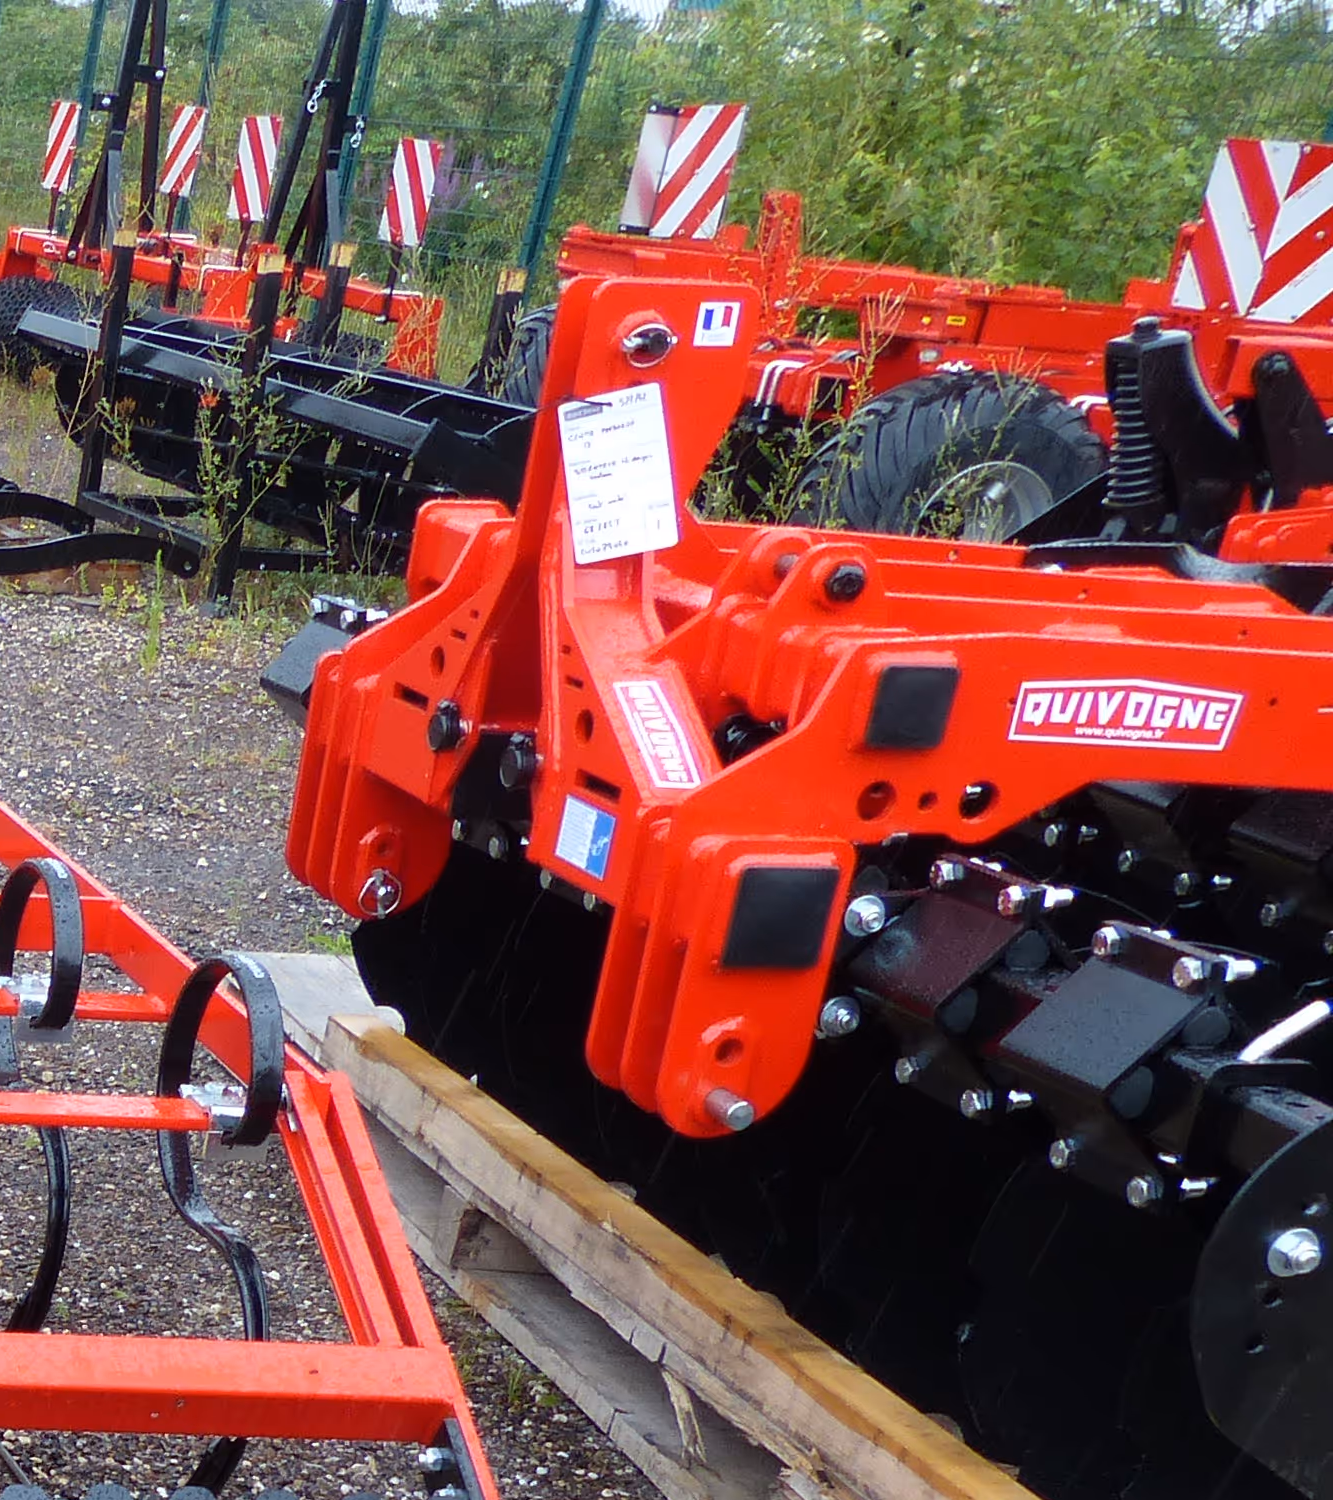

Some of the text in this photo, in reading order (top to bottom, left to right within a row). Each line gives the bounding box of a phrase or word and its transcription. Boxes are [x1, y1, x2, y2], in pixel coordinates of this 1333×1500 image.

[1022, 691, 1230, 730] QUIVOGNE
[628, 686, 689, 783] QUIVOGNE
[1074, 725, 1165, 741] www.quivogne.fr
